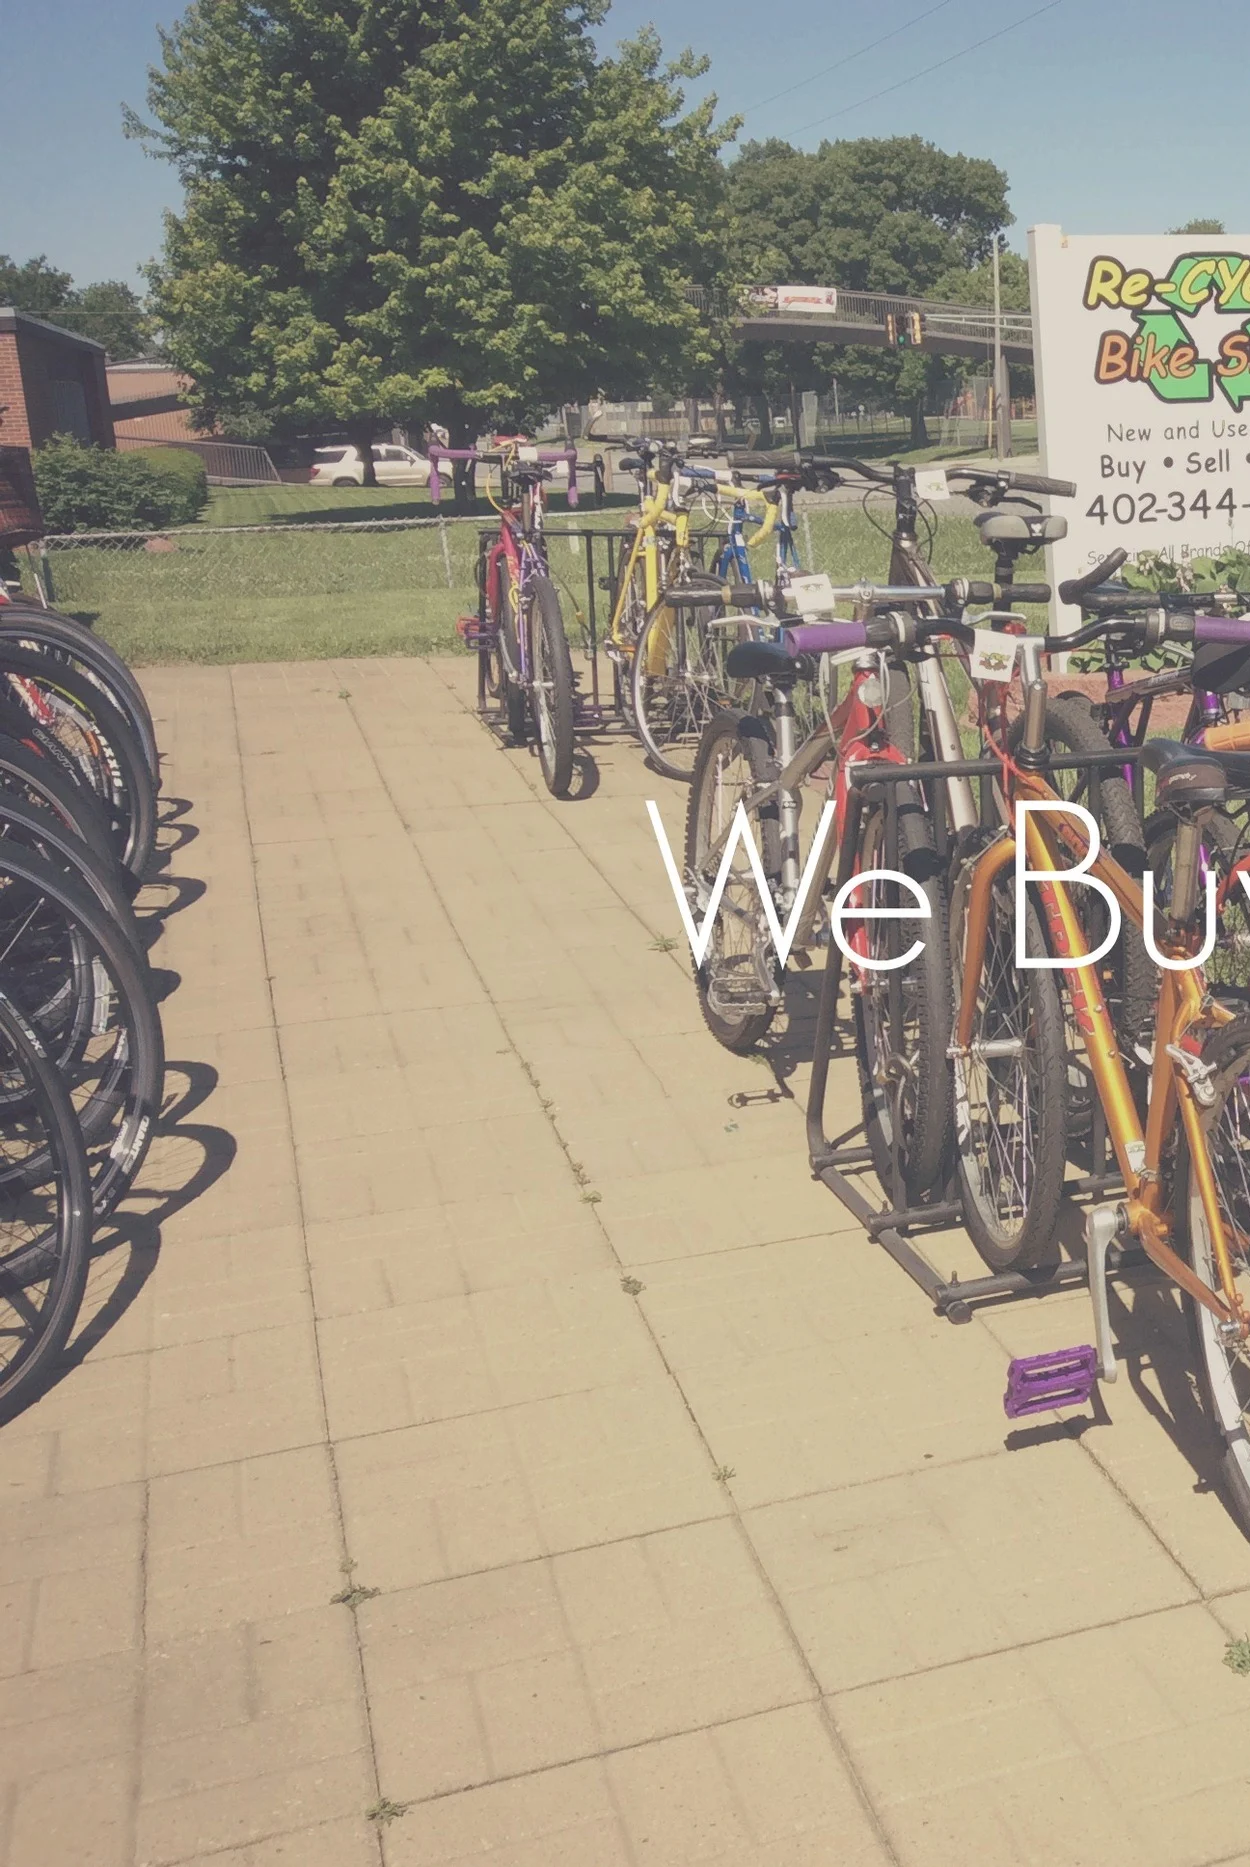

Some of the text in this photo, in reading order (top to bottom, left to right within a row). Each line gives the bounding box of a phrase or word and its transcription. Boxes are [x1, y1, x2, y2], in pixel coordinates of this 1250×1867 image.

[1095, 330, 1199, 384] Bike
[1107, 423, 1151, 443] New
[1164, 420, 1200, 440] and
[1100, 454, 1146, 484] Buy
[1186, 448, 1230, 474] Sell
[1159, 544, 1175, 560] All
